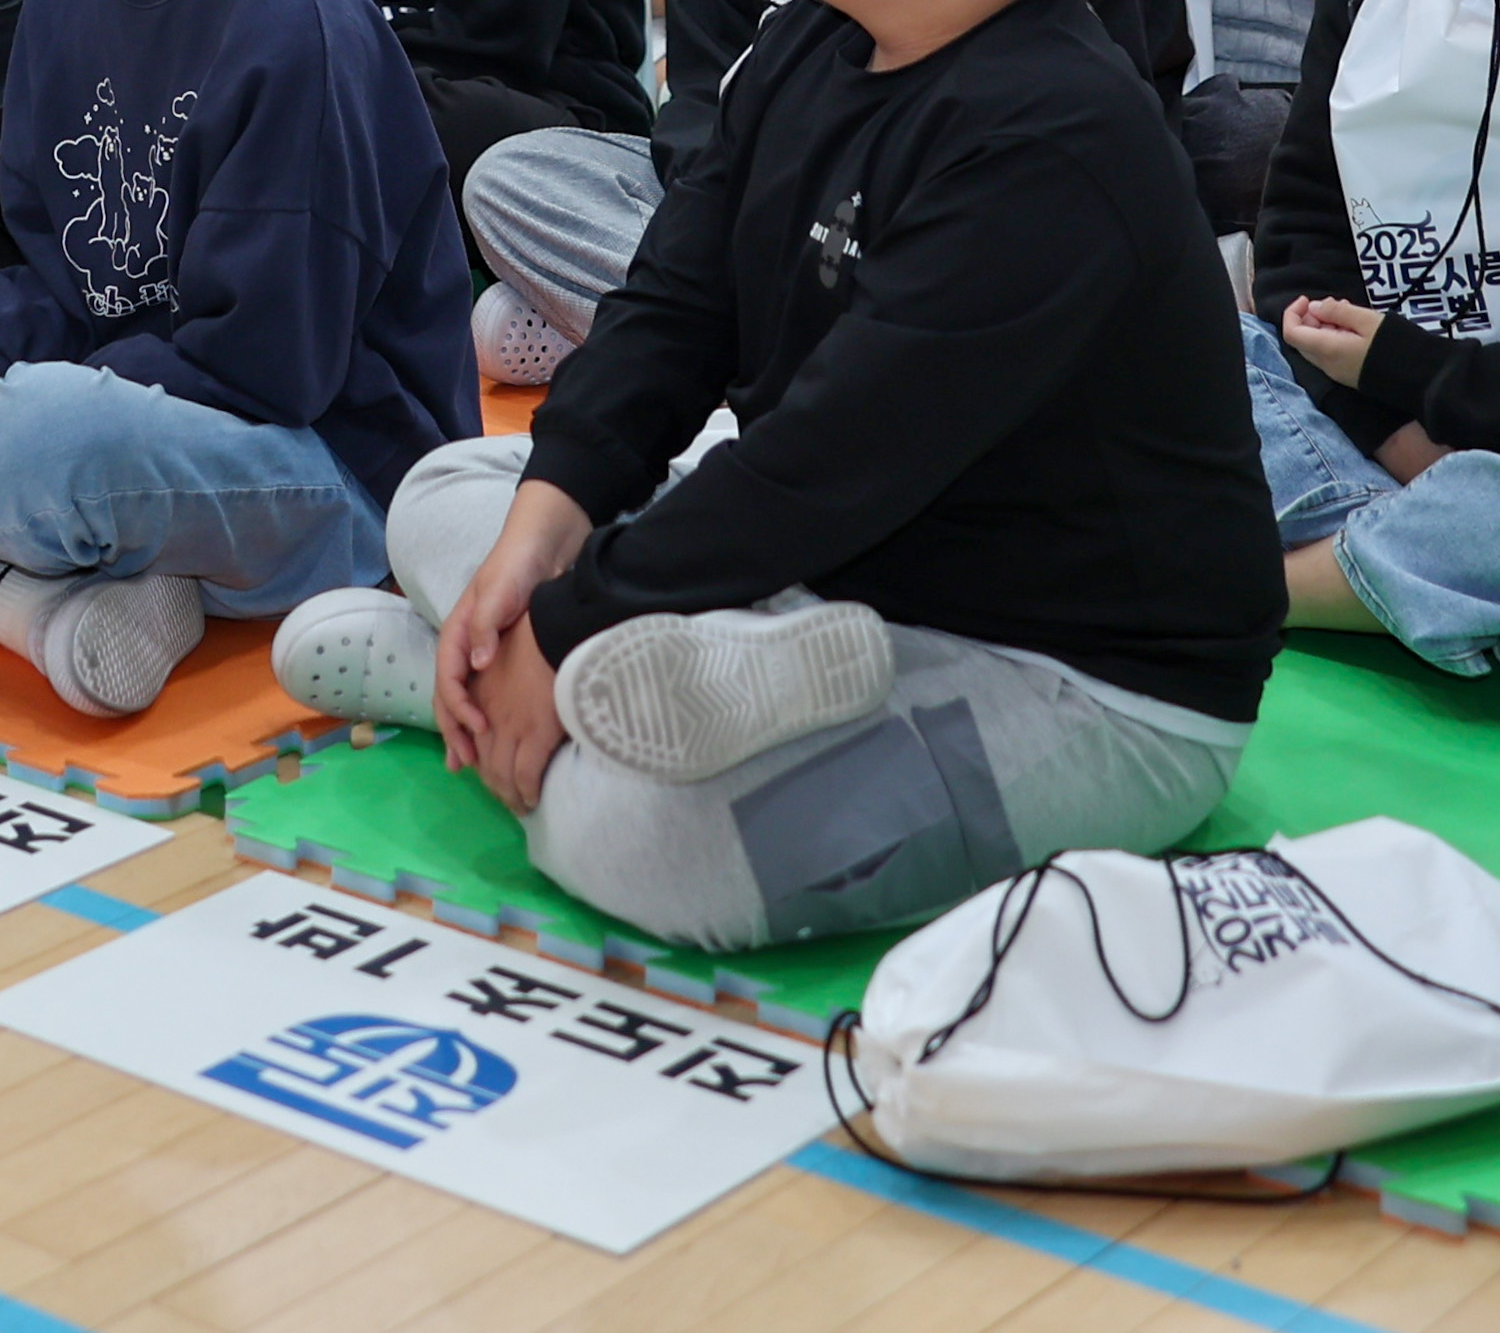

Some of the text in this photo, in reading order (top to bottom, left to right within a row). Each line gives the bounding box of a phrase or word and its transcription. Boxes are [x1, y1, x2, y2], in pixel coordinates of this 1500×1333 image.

[1356, 226, 1441, 262] 2025
[249, 902, 803, 1102] 진도초 1반
